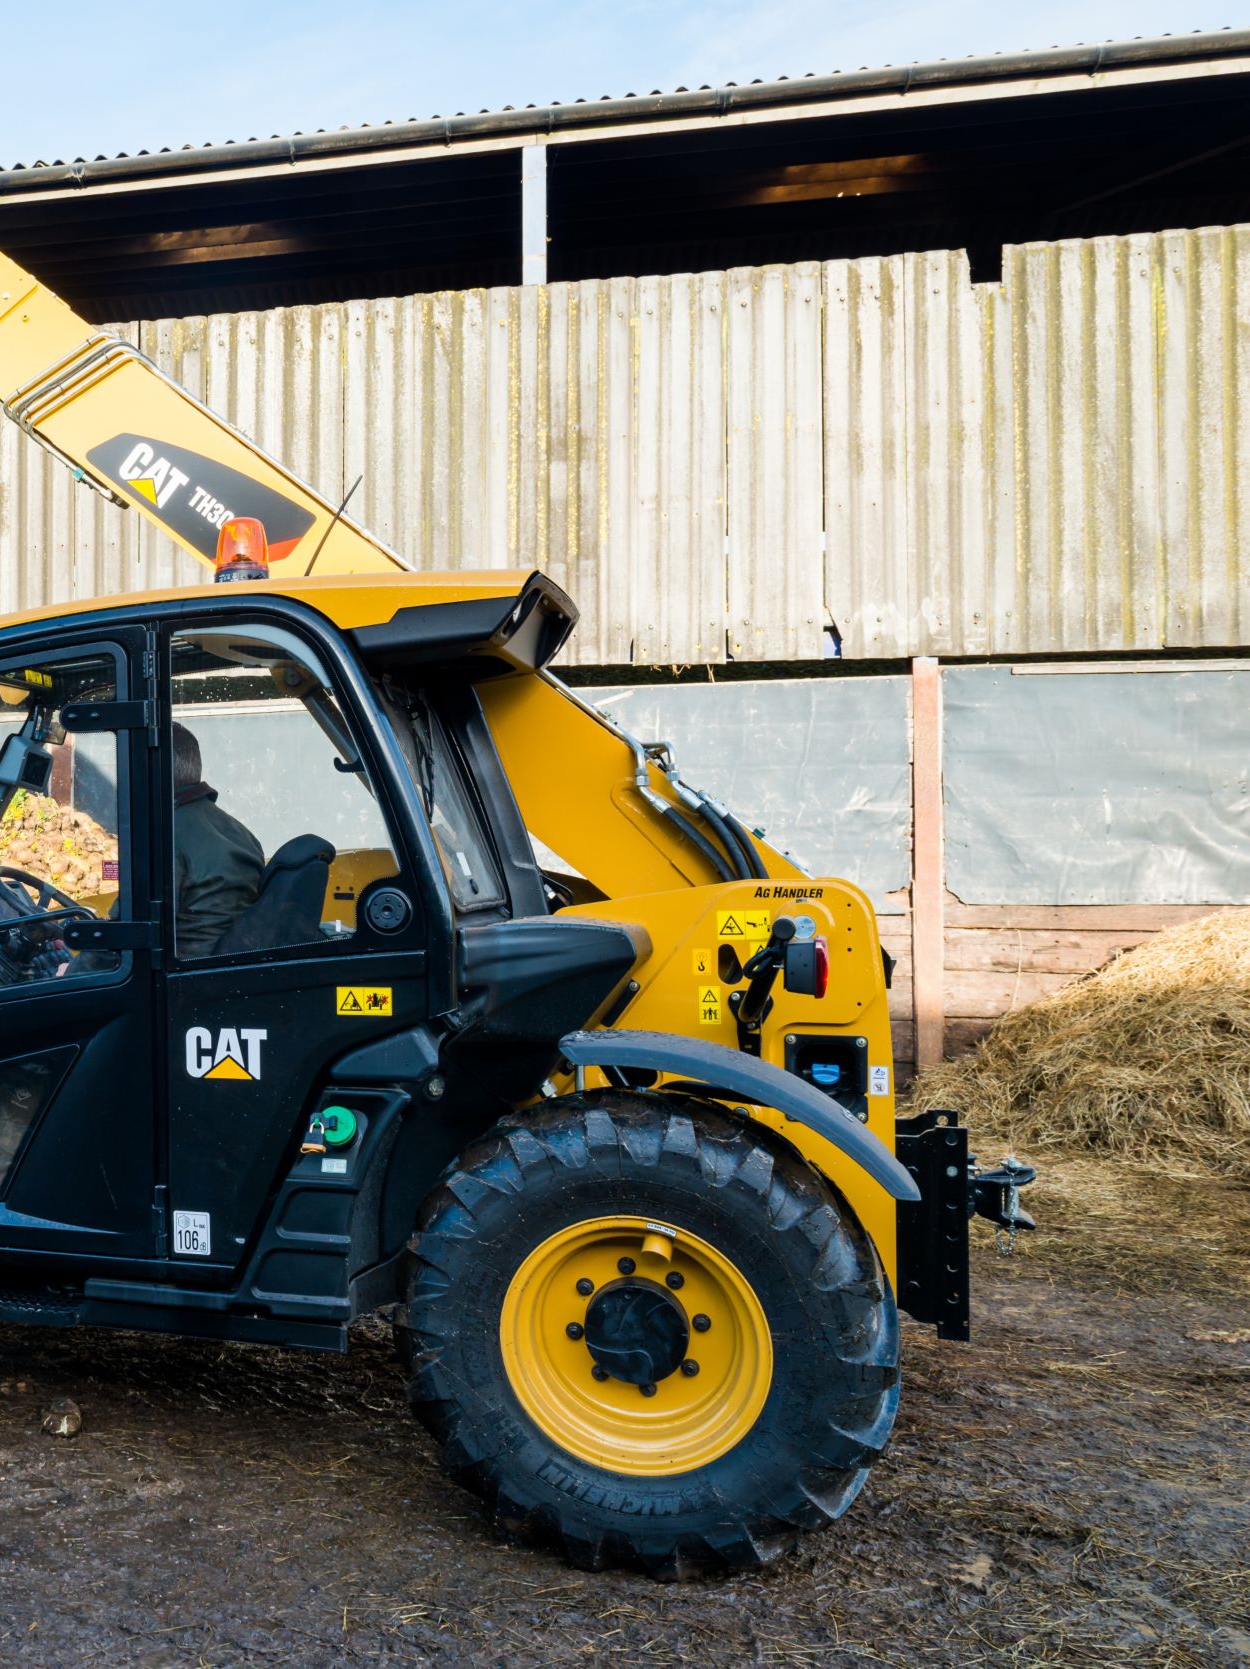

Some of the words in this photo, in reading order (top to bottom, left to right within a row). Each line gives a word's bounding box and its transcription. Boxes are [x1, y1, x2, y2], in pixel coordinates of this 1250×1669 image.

[118, 442, 190, 509] CAT
[188, 486, 234, 530] TH30
[773, 886, 823, 899] HANDLER
[185, 1026, 268, 1080] CAT
[178, 1229, 199, 1251] 106
